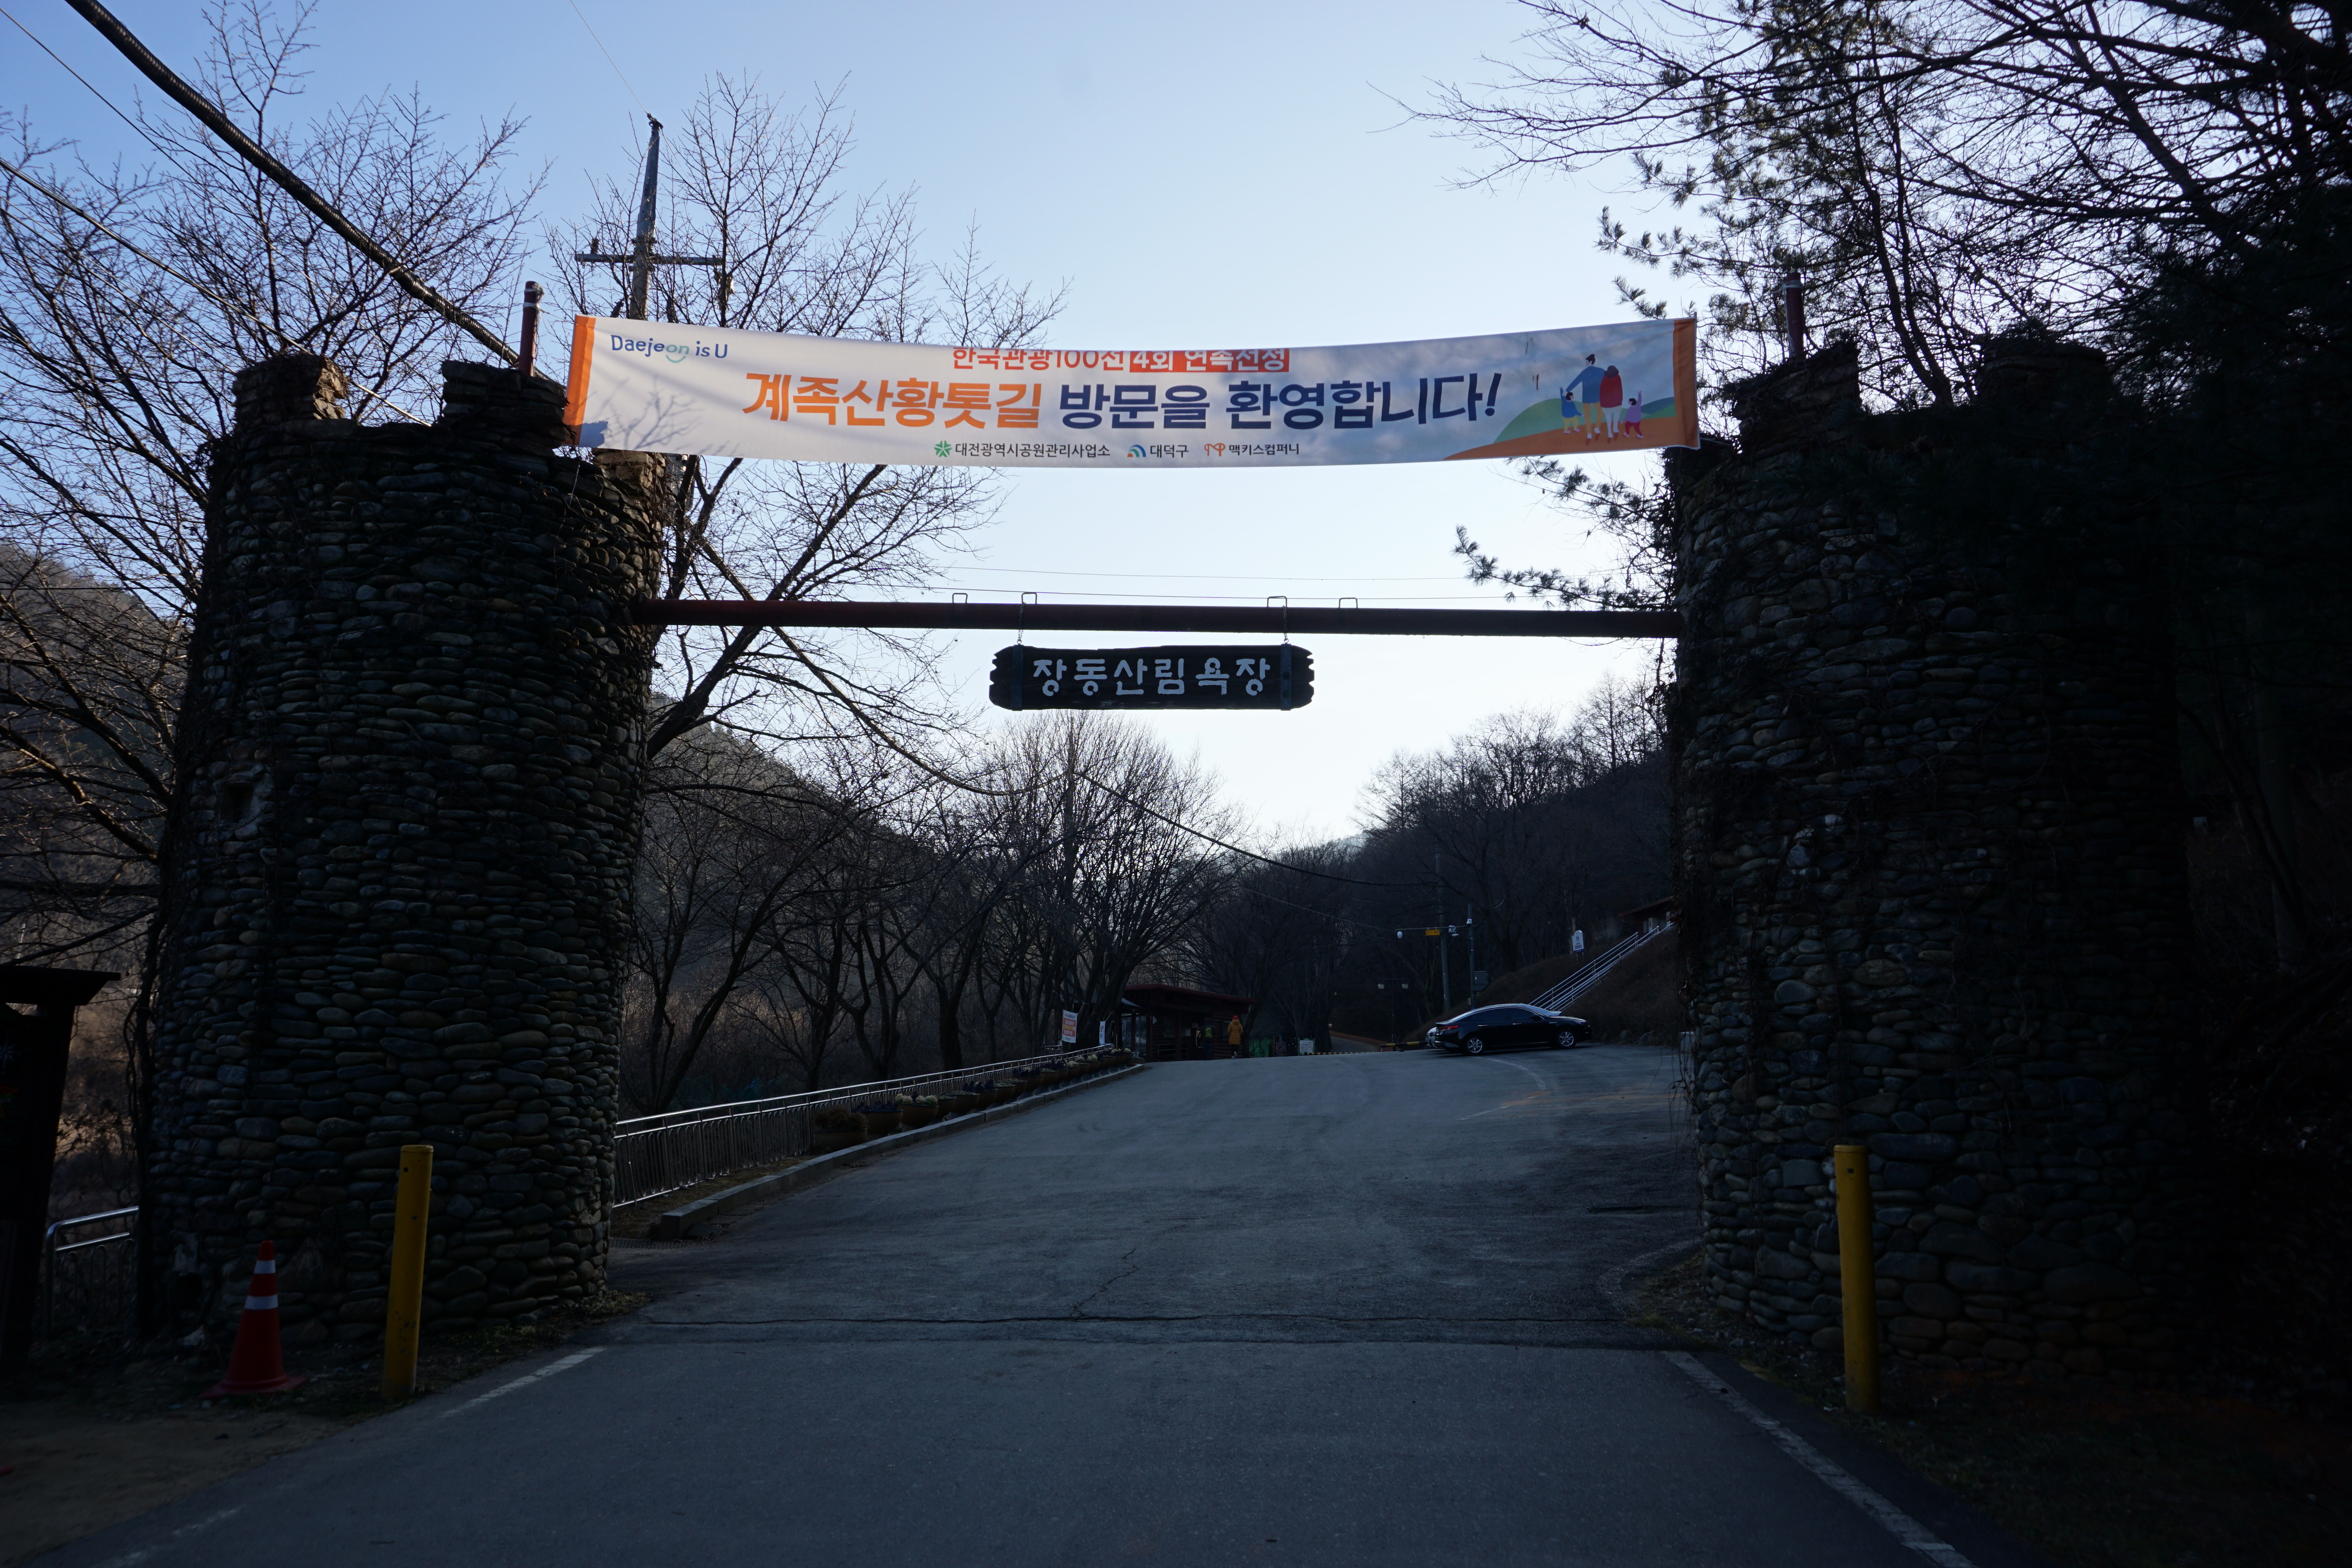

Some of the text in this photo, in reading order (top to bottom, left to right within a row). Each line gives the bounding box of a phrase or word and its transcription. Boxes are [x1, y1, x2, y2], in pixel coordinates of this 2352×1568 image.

[611, 334, 728, 359] Daejeon is U
[953, 347, 1285, 371] 한국관광100선 4회 연속선정
[742, 372, 1502, 430] 계족산황톳길 방문을 환영합니다!
[955, 443, 1111, 458] 대전광역시공원관리사업소
[1150, 444, 1189, 458] 대덕구
[1229, 443, 1299, 456] 맥키스컴퍼니
[1033, 657, 1270, 696] 장동산림욕장
